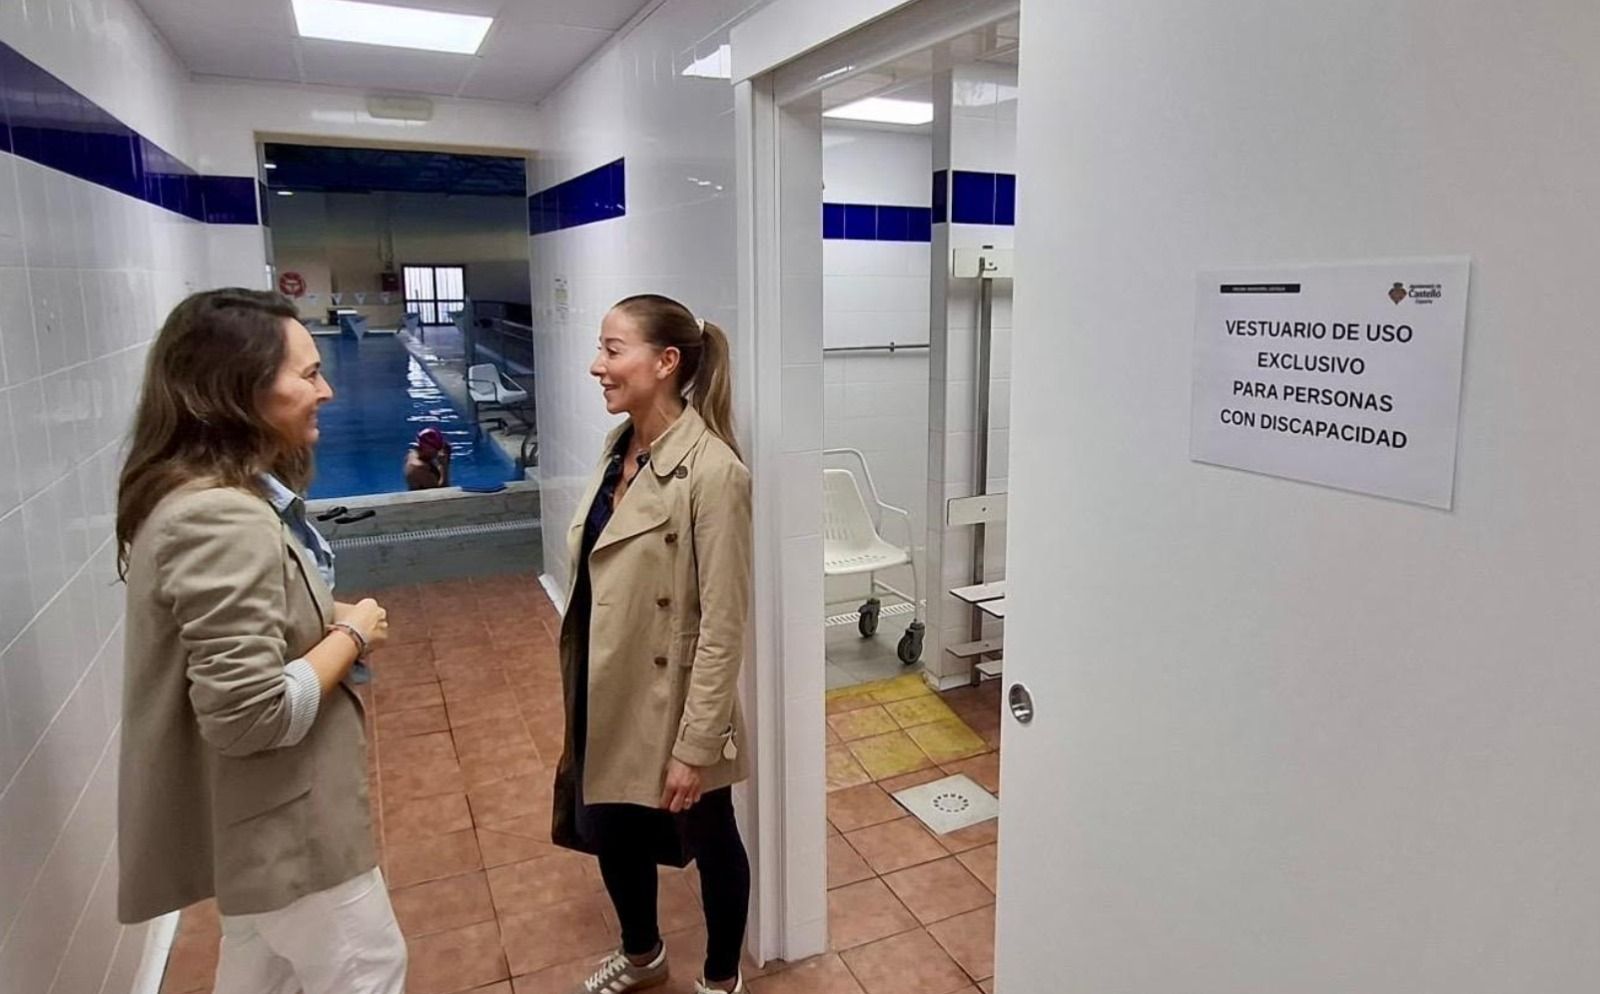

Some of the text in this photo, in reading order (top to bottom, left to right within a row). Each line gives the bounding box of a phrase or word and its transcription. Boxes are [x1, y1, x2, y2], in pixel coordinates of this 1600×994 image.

[1225, 319, 1414, 344] VESTUARIO DE USO
[1257, 351, 1366, 376] EXCLUSIVO
[1232, 380, 1394, 413] PARA PERSONAS
[1220, 408, 1408, 449] CON DISCAPACIDAD
